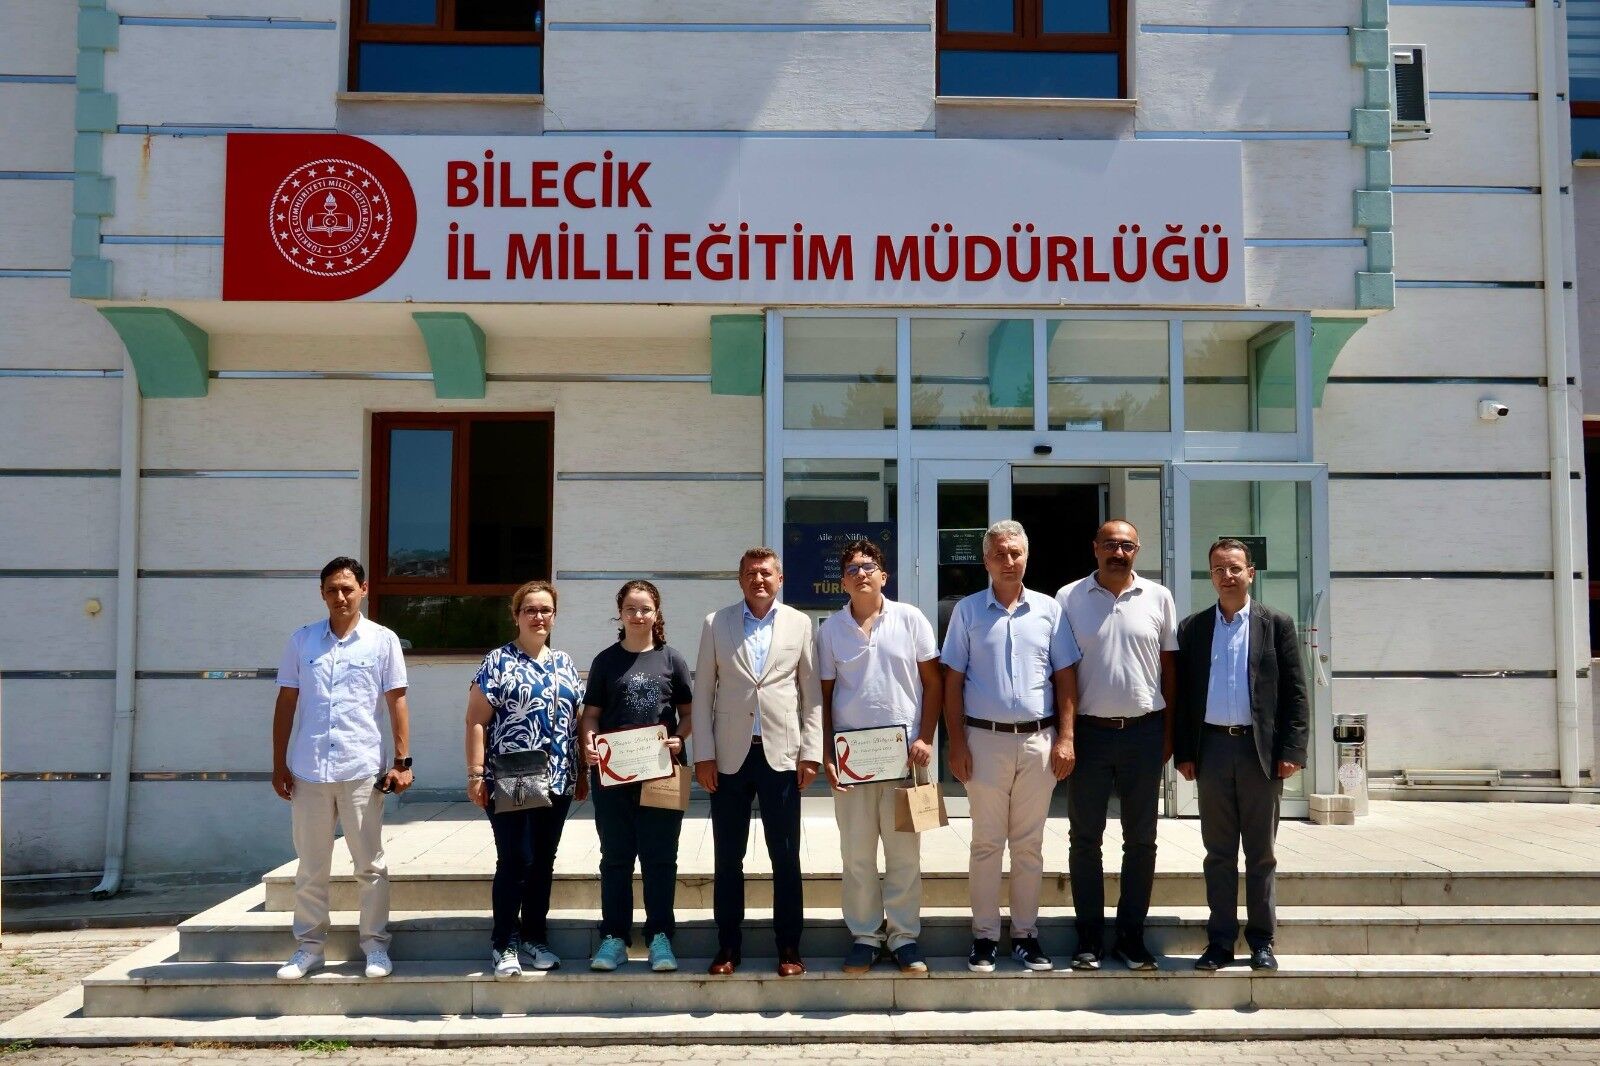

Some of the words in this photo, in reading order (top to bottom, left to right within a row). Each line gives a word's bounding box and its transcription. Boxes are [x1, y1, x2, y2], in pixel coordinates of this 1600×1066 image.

[447, 149, 652, 209] BİLECİK
[447, 221, 491, 280] İL
[506, 222, 654, 280] MİLLÎ
[664, 222, 854, 281] EĞİTİM
[874, 222, 1229, 283] MÜDÜRLÜĞÜ
[817, 533, 833, 541] Aile
